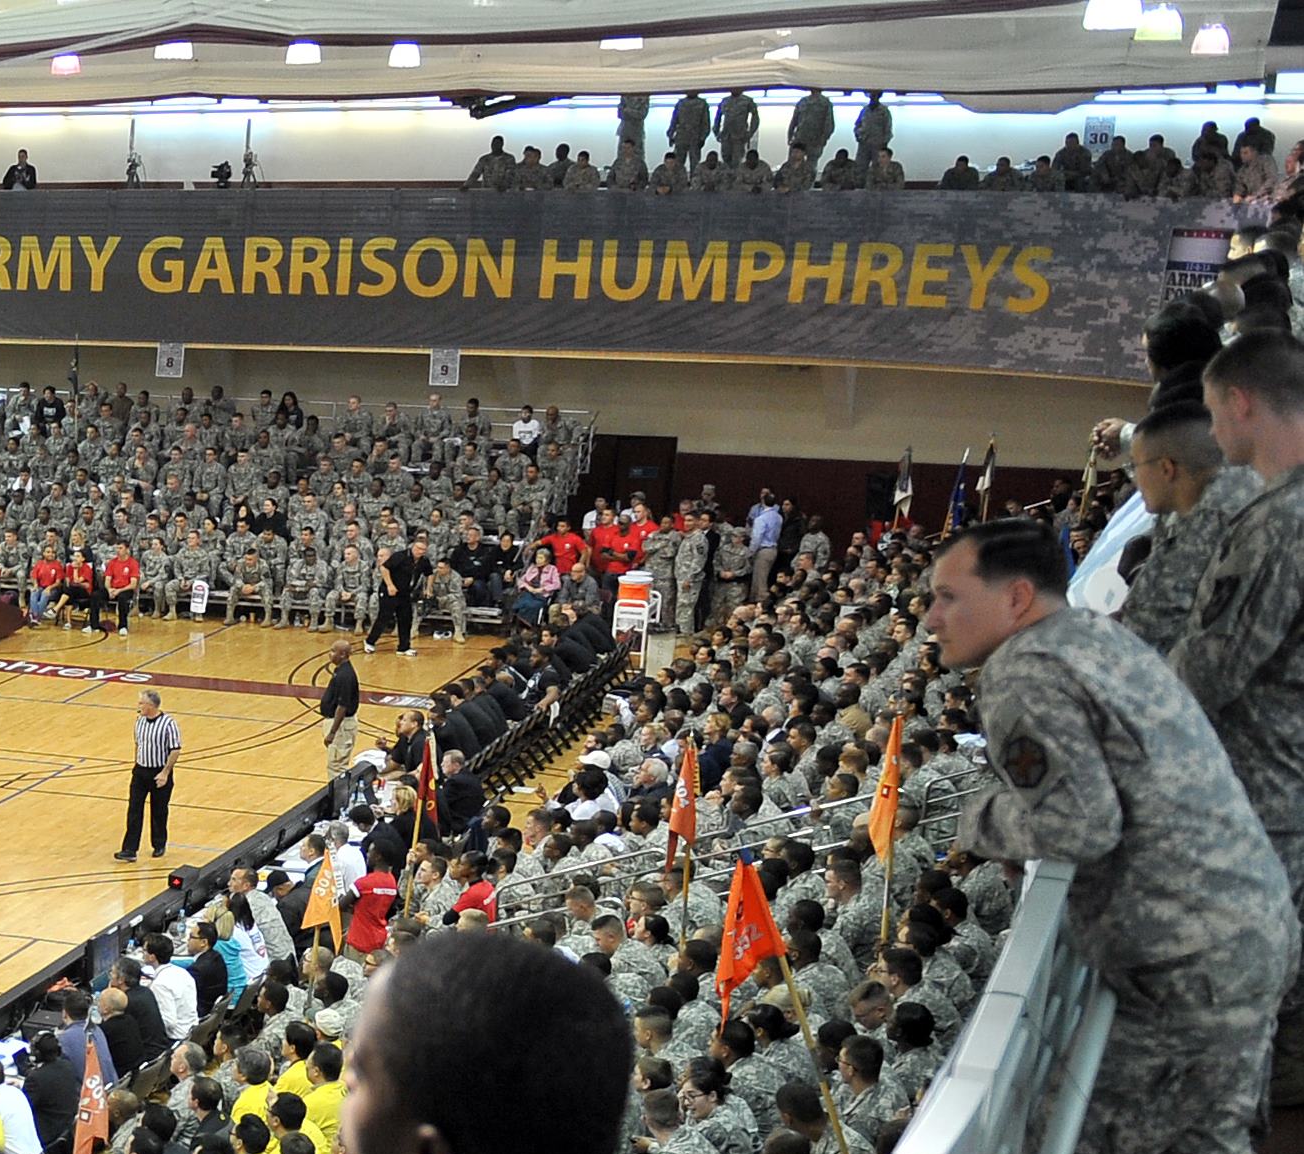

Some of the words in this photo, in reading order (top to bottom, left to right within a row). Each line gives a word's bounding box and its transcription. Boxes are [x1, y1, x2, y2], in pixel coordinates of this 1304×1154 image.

[1089, 132, 1109, 145] 30
[138, 236, 510, 299] GARRISON
[538, 239, 1053, 314] HUMPHREYS
[166, 357, 174, 368] 8
[440, 364, 449, 376] 9
